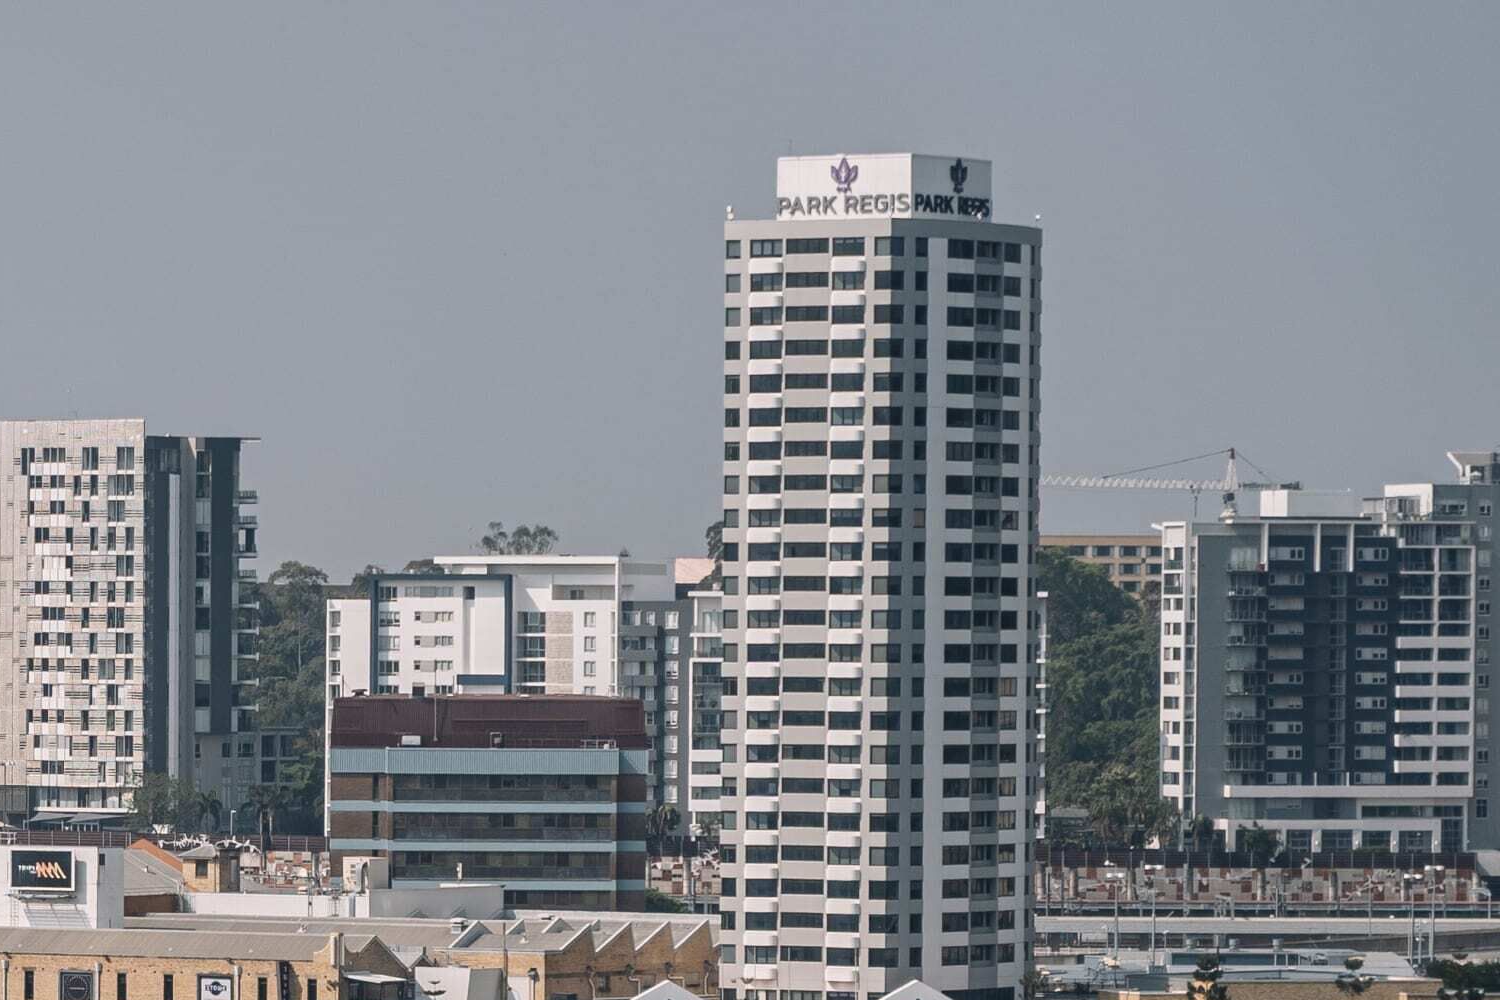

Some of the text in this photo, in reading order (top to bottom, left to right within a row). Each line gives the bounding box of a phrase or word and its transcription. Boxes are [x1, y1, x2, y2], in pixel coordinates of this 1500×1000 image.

[778, 193, 911, 217] PARK REGIS
[914, 193, 956, 214] PARK
